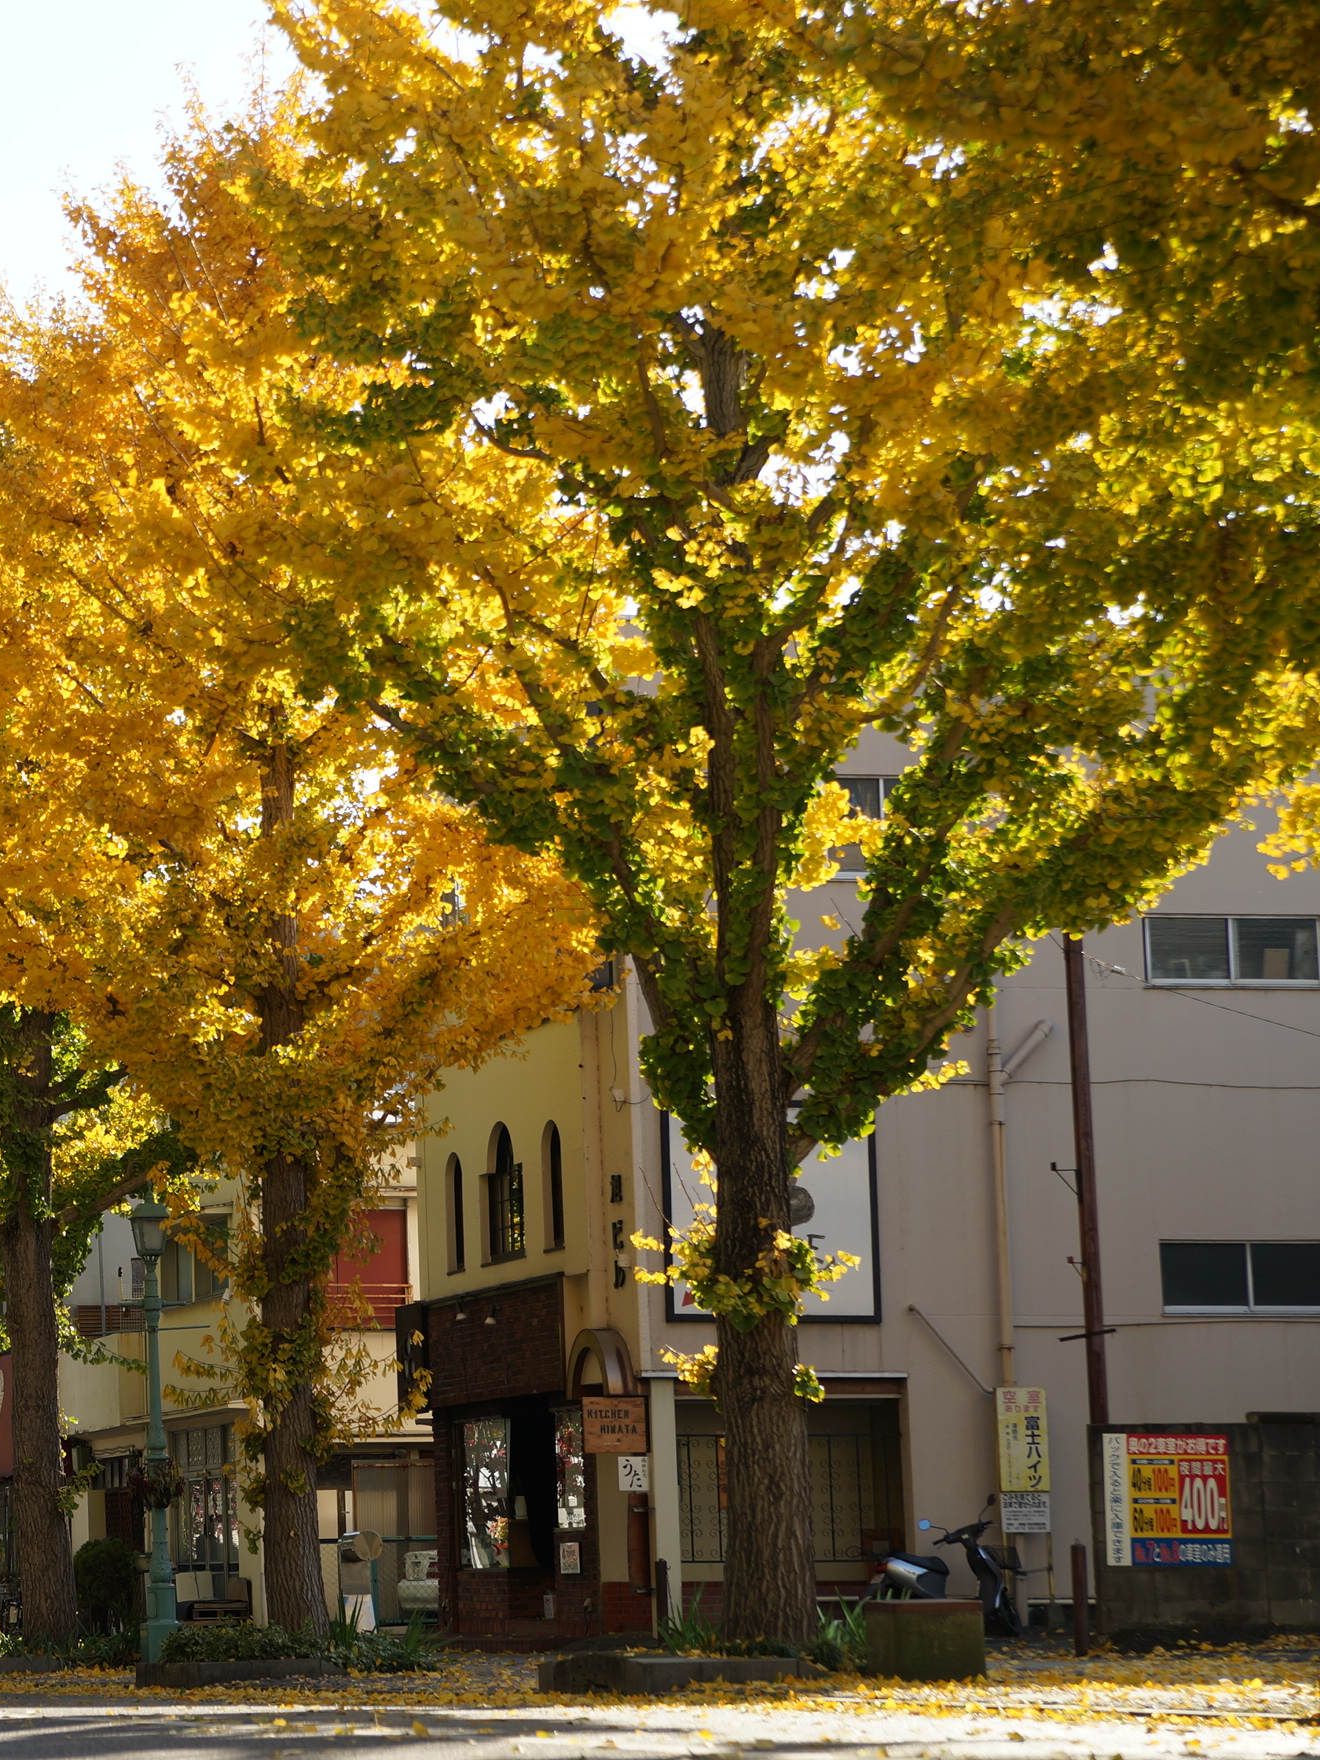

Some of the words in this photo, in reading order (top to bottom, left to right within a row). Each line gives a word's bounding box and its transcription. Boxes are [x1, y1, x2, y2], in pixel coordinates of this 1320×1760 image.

[1002, 1390, 1041, 1404] 空室
[587, 1409, 629, 1419] KITCHEN
[1005, 1404, 1039, 1413] あります
[600, 1424, 638, 1434] HINATA
[1024, 1415, 1042, 1489] 富士ハイツ
[623, 1459, 642, 1488] うた
[1180, 1461, 1225, 1475] 夜間最大
[1181, 1477, 1228, 1531] 400円
